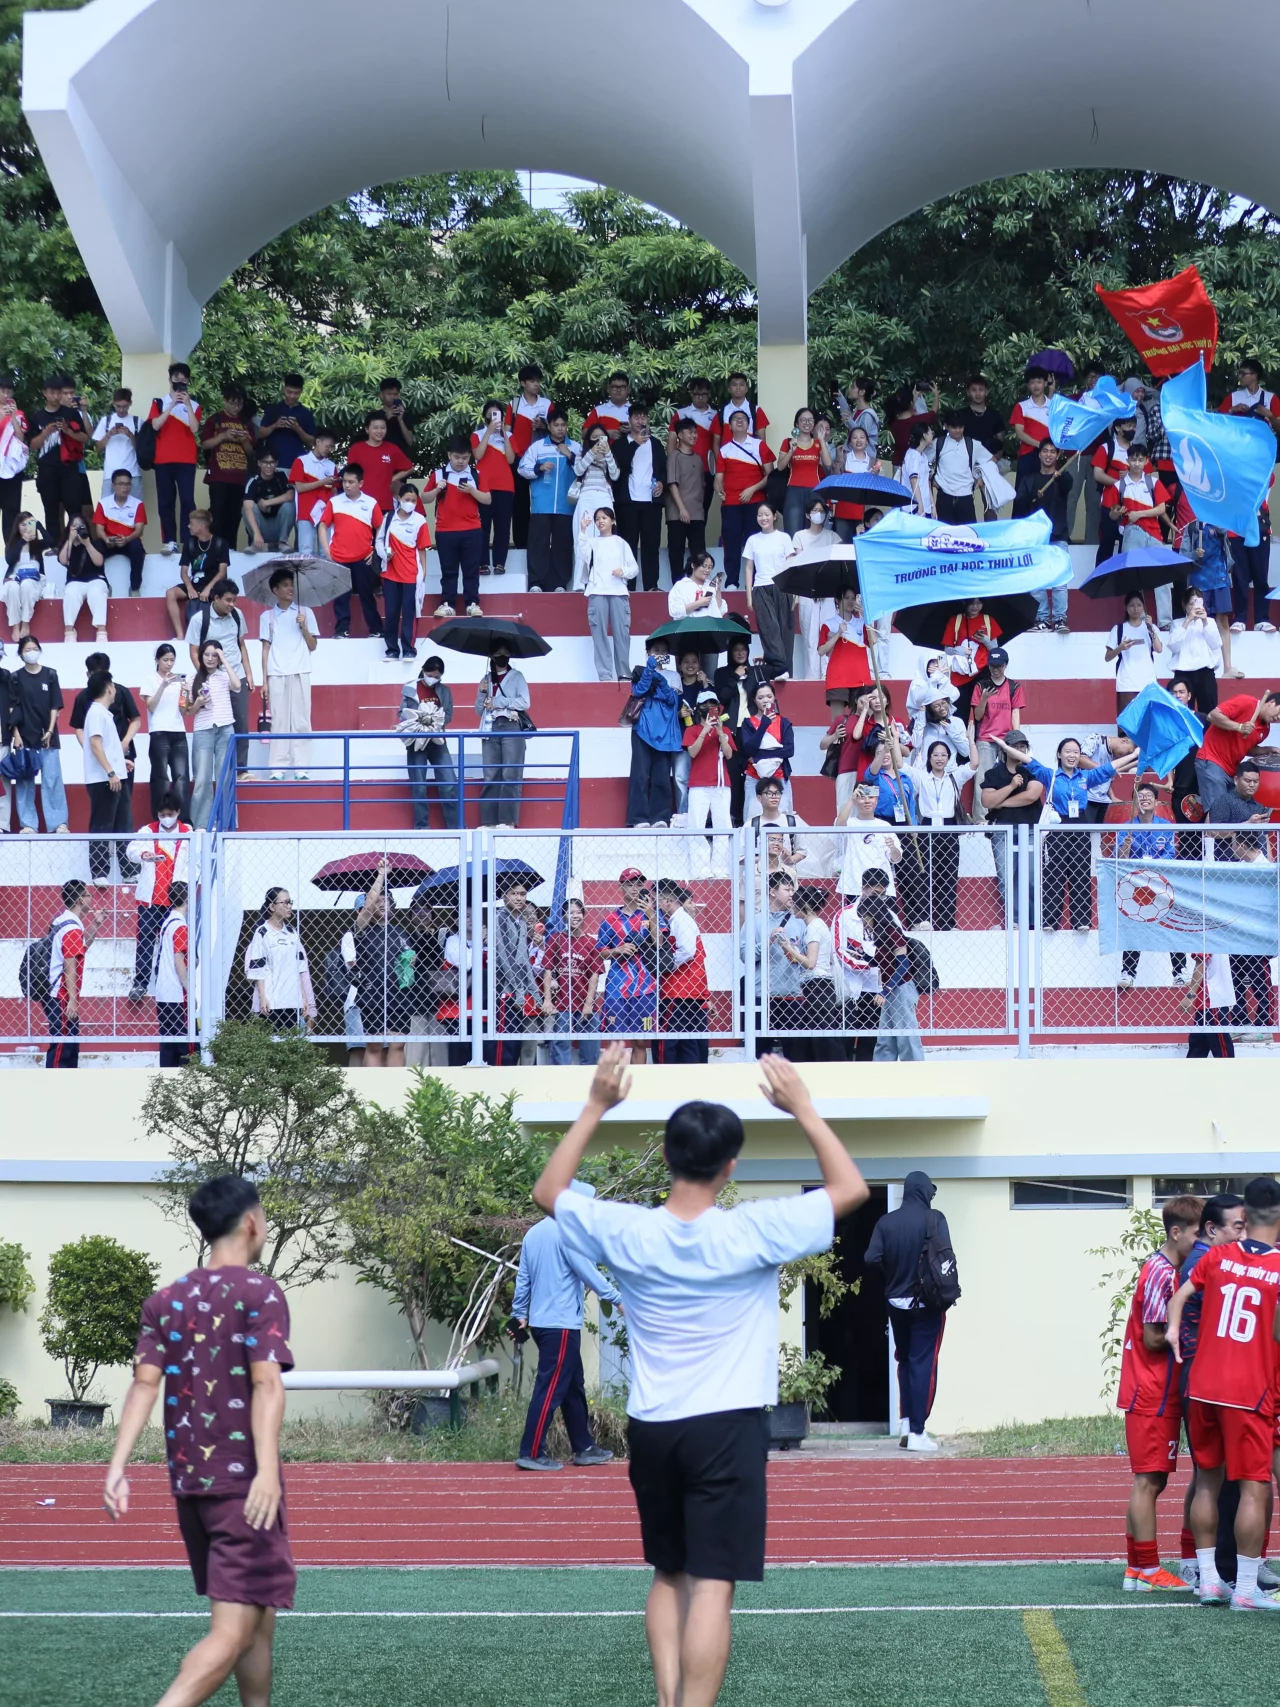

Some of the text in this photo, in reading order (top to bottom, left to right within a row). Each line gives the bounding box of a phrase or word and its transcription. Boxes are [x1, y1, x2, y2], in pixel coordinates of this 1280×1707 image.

[894, 566, 937, 584] TRƯỜNG
[939, 563, 957, 575] ĐẠI
[961, 560, 984, 572] HỌC
[1017, 553, 1034, 567] LỢI
[1217, 1282, 1261, 1343] 16
[1168, 1440, 1178, 1460] 2
